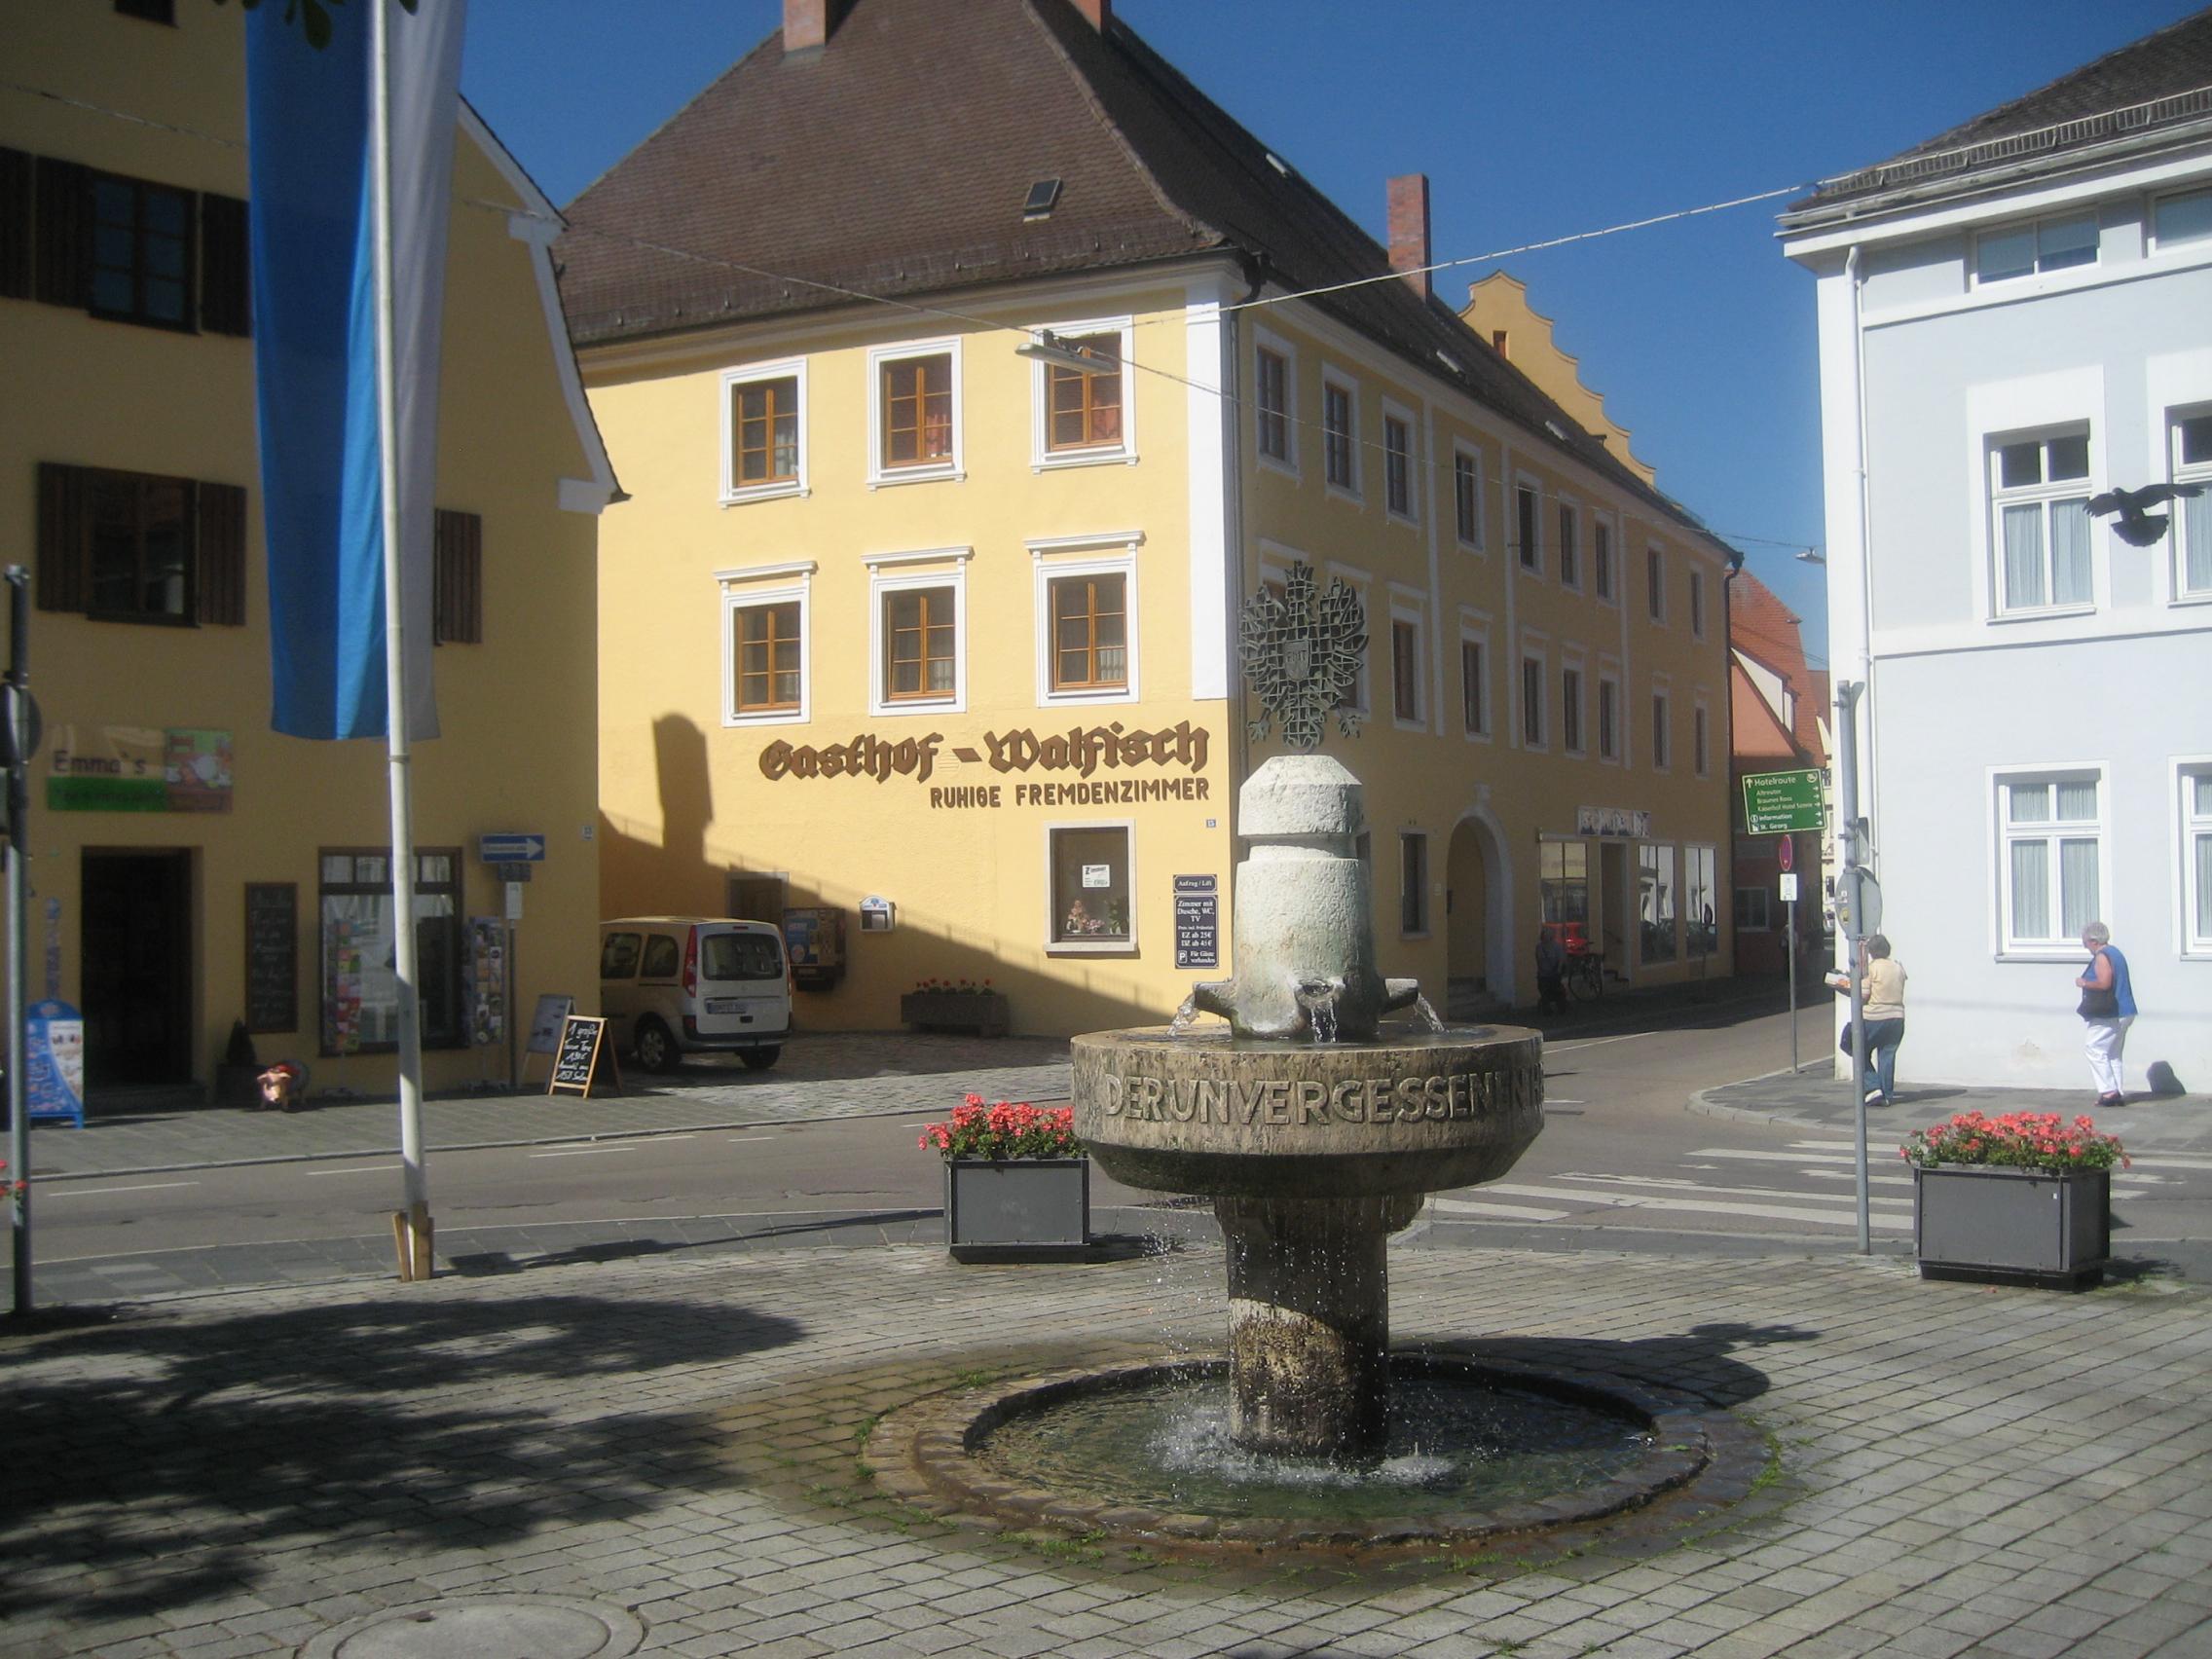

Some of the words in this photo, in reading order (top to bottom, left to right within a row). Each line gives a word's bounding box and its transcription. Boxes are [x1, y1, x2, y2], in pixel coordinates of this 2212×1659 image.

[759, 733, 943, 783] Gasthof
[983, 720, 1209, 780] Walfisch
[930, 785, 1001, 809] RUHIGE
[1015, 778, 1209, 806] FREMDENZIMMER
[1754, 777, 1796, 787] Hotelroute
